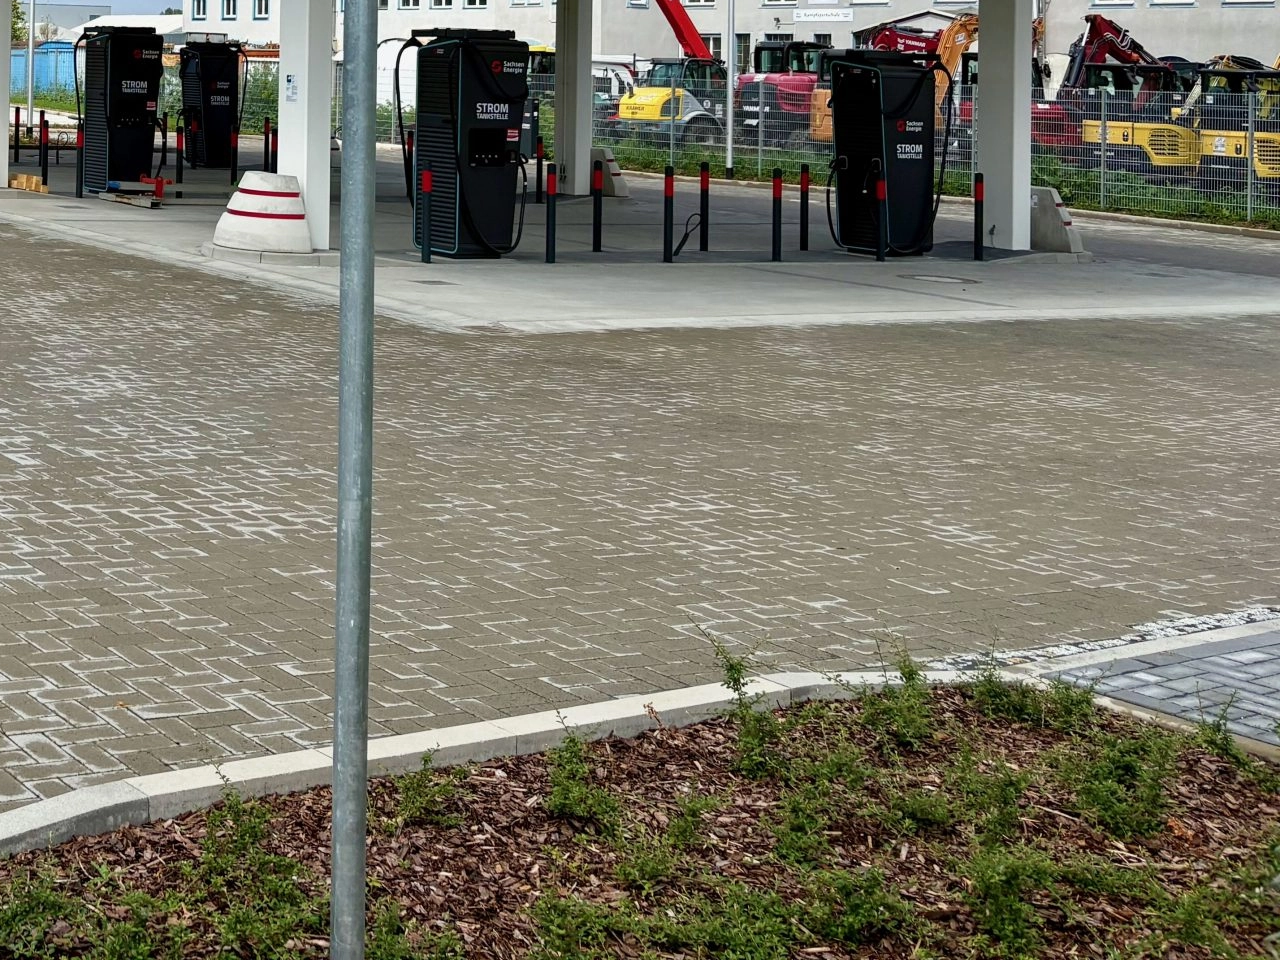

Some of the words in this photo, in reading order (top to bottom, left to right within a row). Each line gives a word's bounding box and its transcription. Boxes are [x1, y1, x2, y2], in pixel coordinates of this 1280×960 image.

[122, 80, 147, 88] STROM
[476, 102, 508, 113] STROM
[896, 144, 923, 153] STROM
